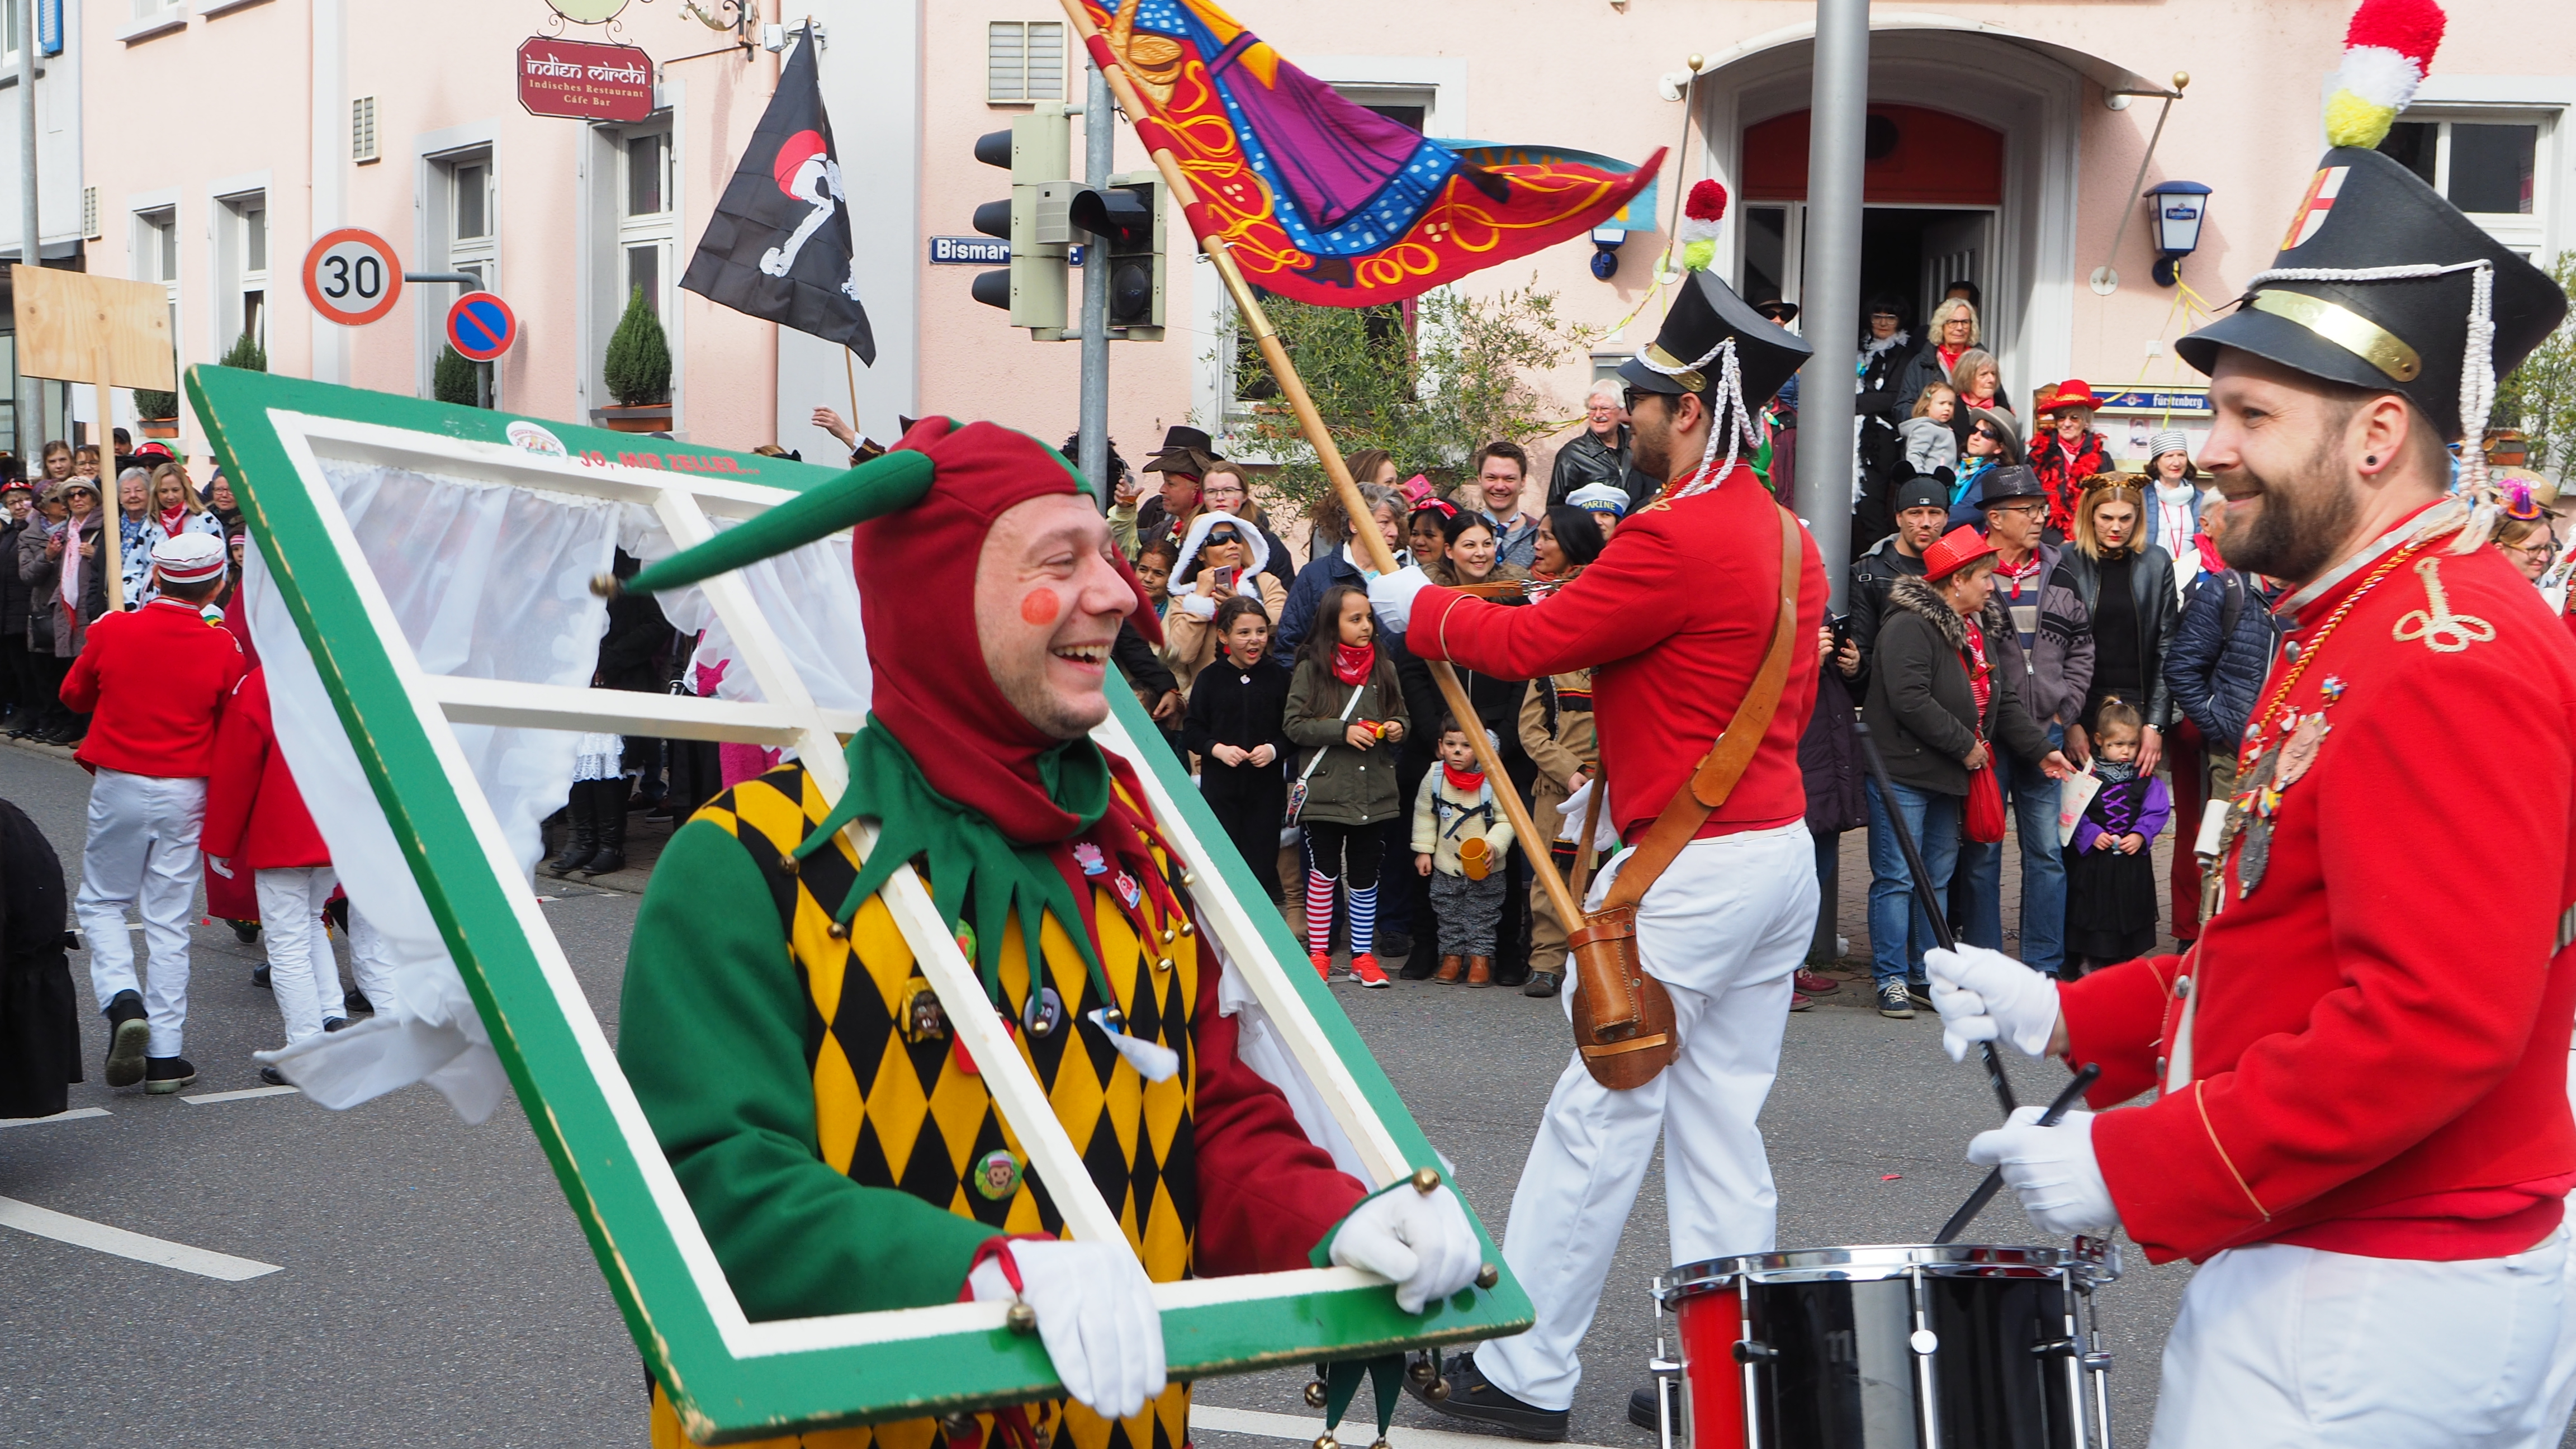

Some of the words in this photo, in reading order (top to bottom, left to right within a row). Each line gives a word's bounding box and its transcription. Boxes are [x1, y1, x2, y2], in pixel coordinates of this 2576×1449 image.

[529, 79, 582, 92] Indisches
[586, 84, 644, 98] Restaurant
[593, 97, 611, 106] Bar
[324, 255, 381, 299] 30
[579, 450, 614, 470] JO,
[618, 452, 666, 471] MIR
[1581, 500, 1616, 510] MARINE
